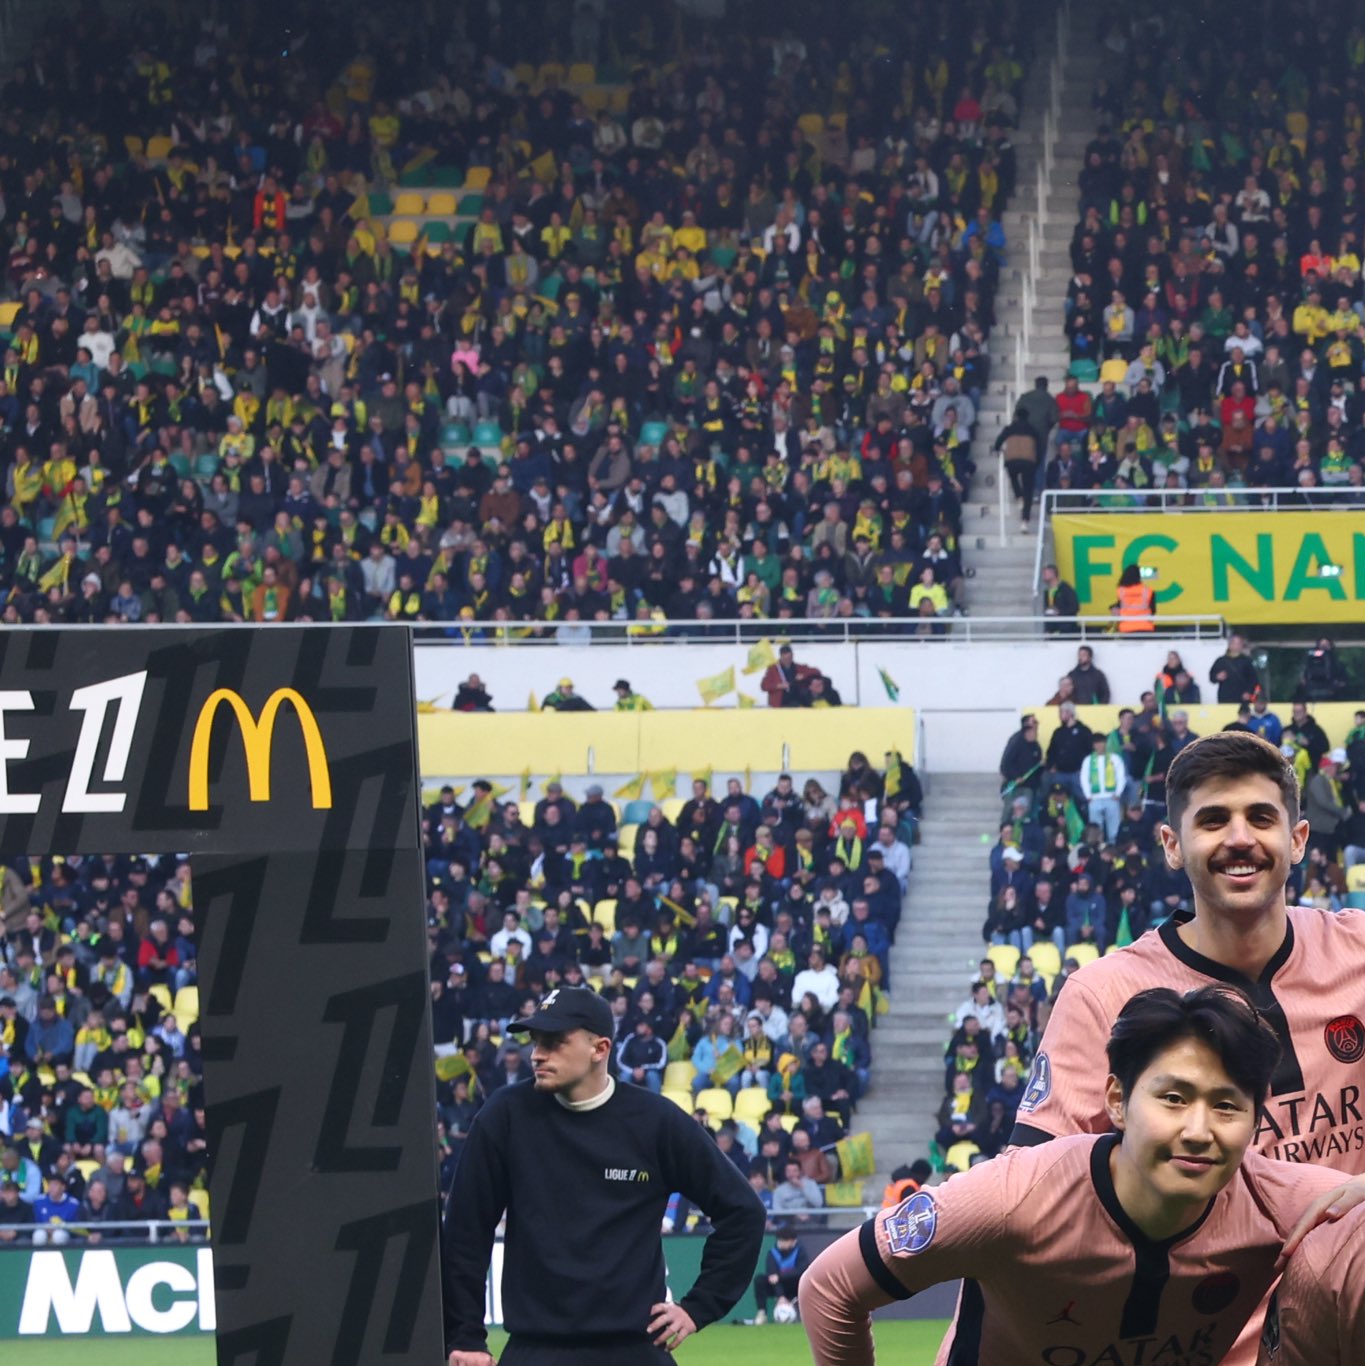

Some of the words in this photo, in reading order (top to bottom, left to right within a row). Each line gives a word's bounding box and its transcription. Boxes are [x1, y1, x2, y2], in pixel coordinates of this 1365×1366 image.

[1071, 532, 1181, 603] FC
[1253, 1085, 1363, 1145] ATAR
[1261, 1126, 1365, 1162] IRWAYS
[604, 1168, 628, 1181] LIGUE
[19, 1250, 215, 1336] Mc
